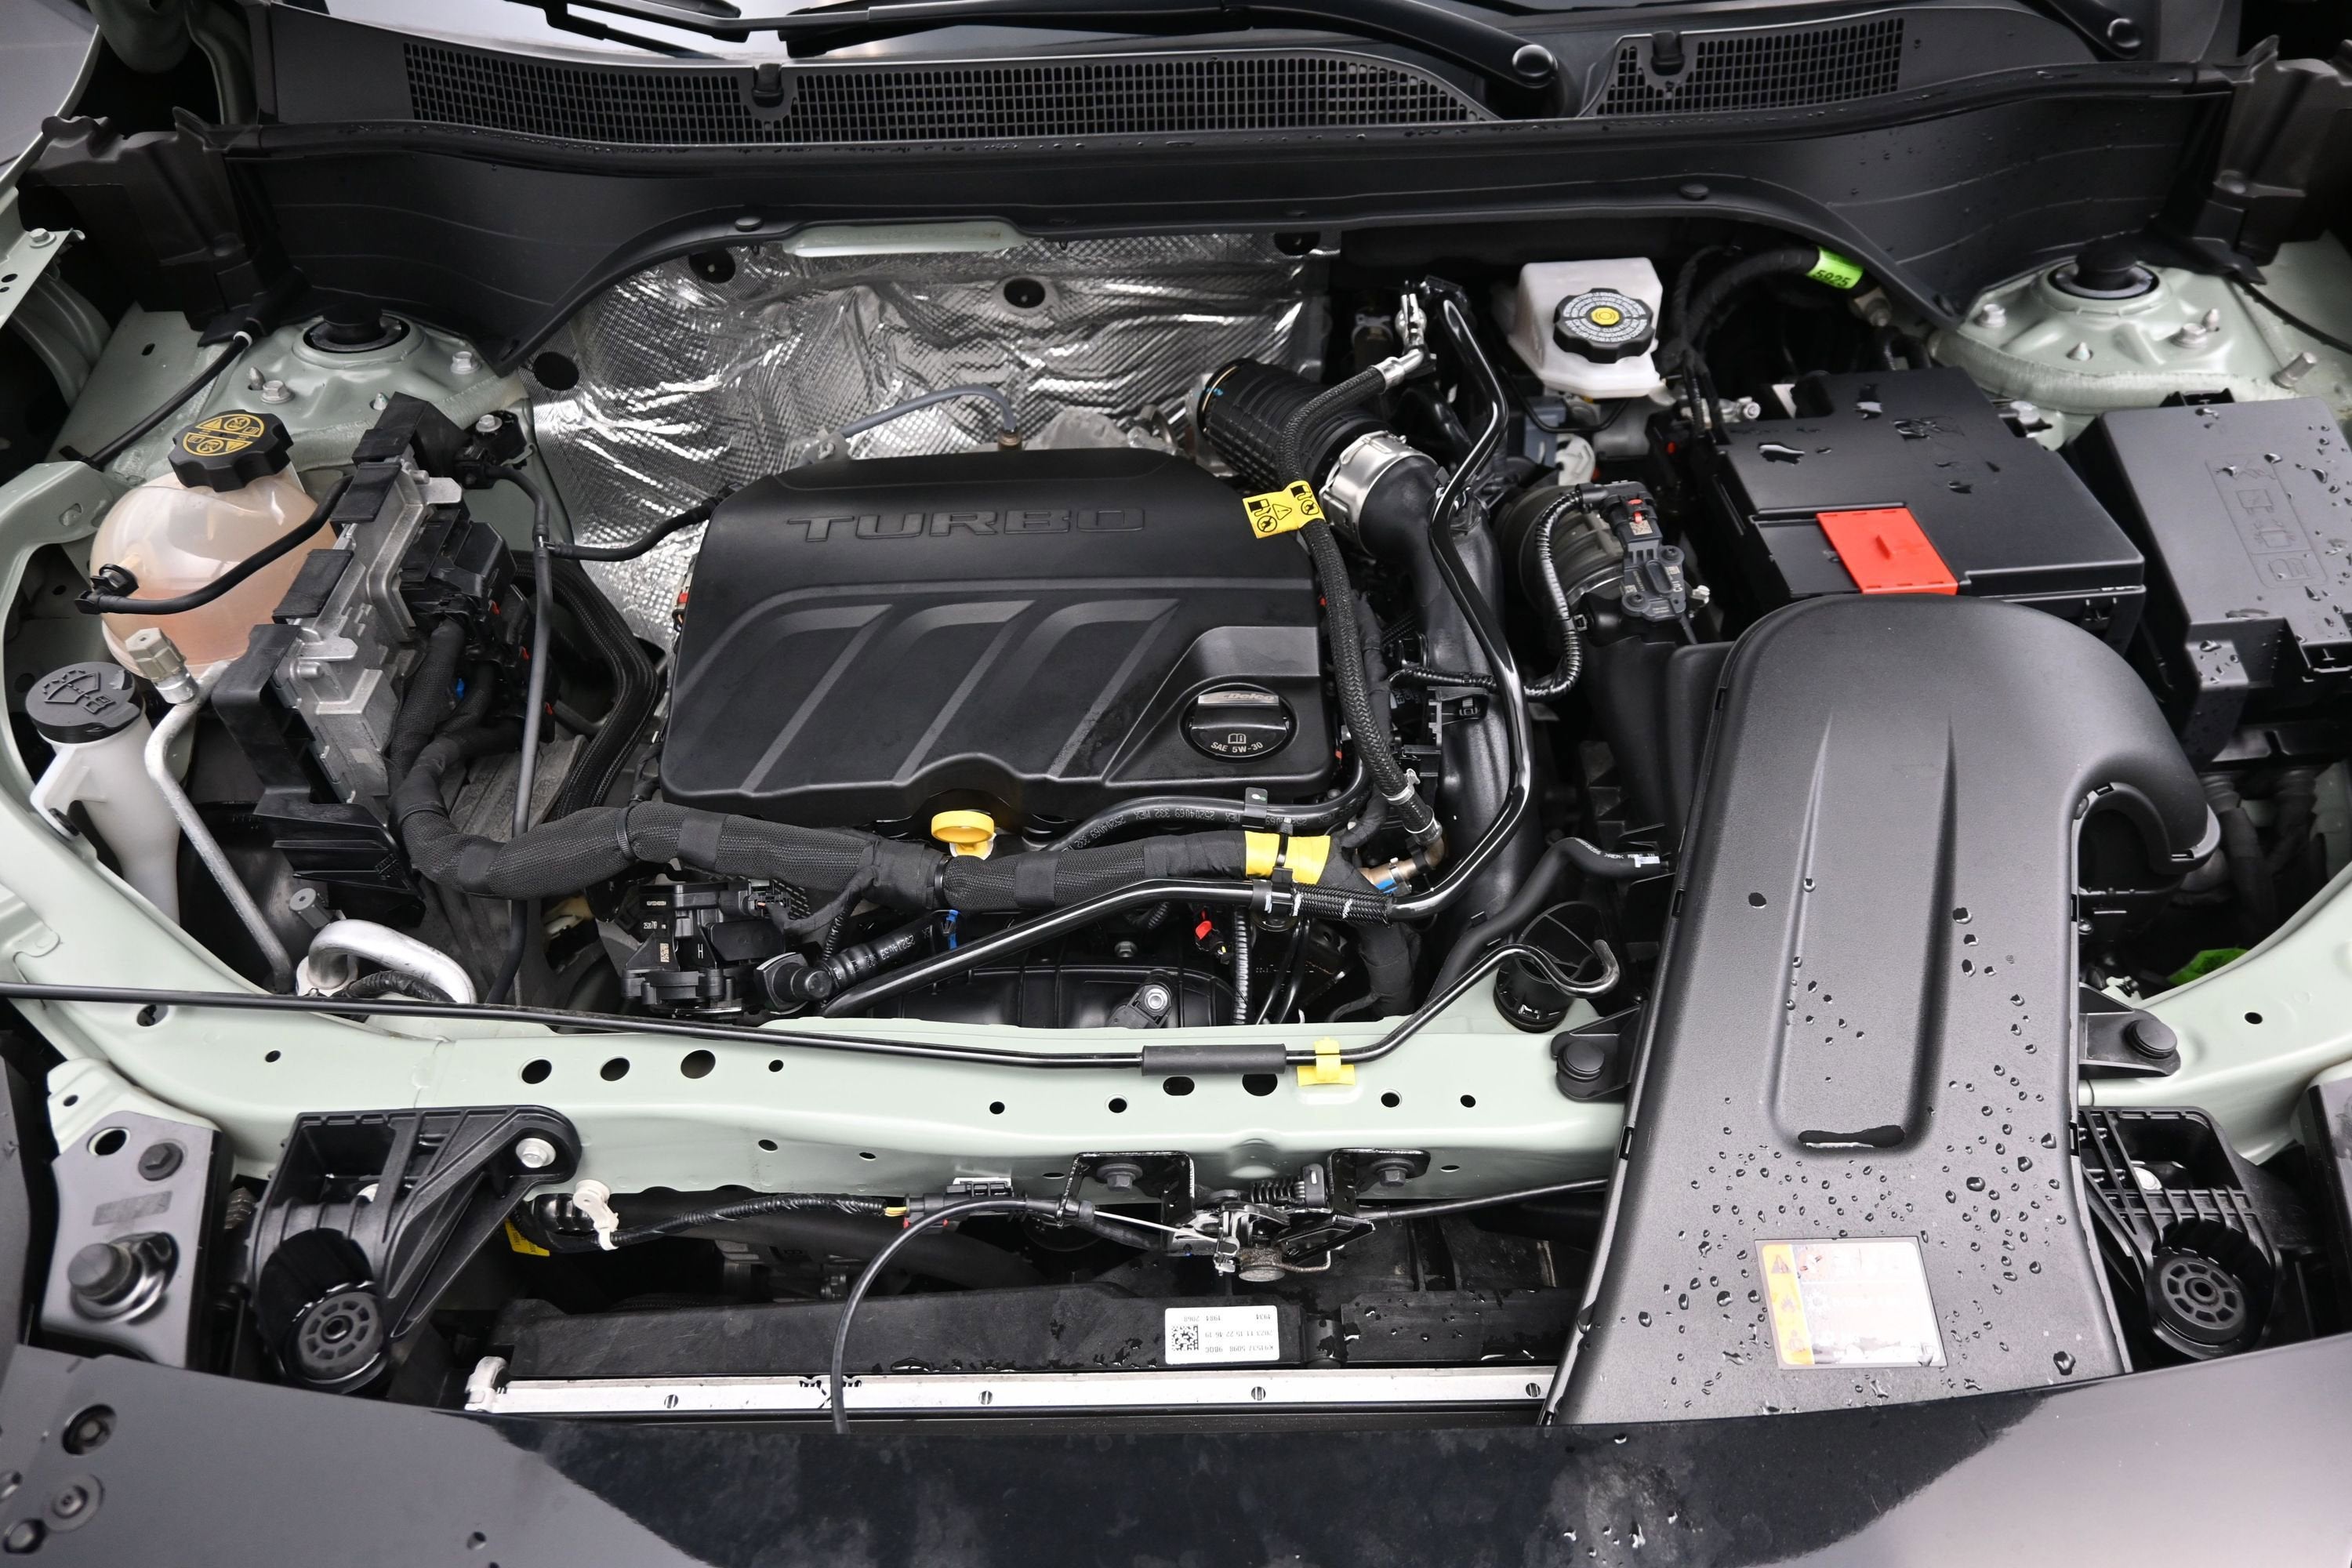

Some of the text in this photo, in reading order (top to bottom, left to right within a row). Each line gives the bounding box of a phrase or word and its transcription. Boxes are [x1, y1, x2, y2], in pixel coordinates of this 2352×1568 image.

[1811, 270, 1852, 287] 5925
[786, 507, 1145, 543] TURBO
[1210, 741, 1264, 753] SAE 5W-30
[1153, 809, 1171, 818] 332
[1174, 808, 1215, 822] 25204069
[697, 943, 704, 960] H
